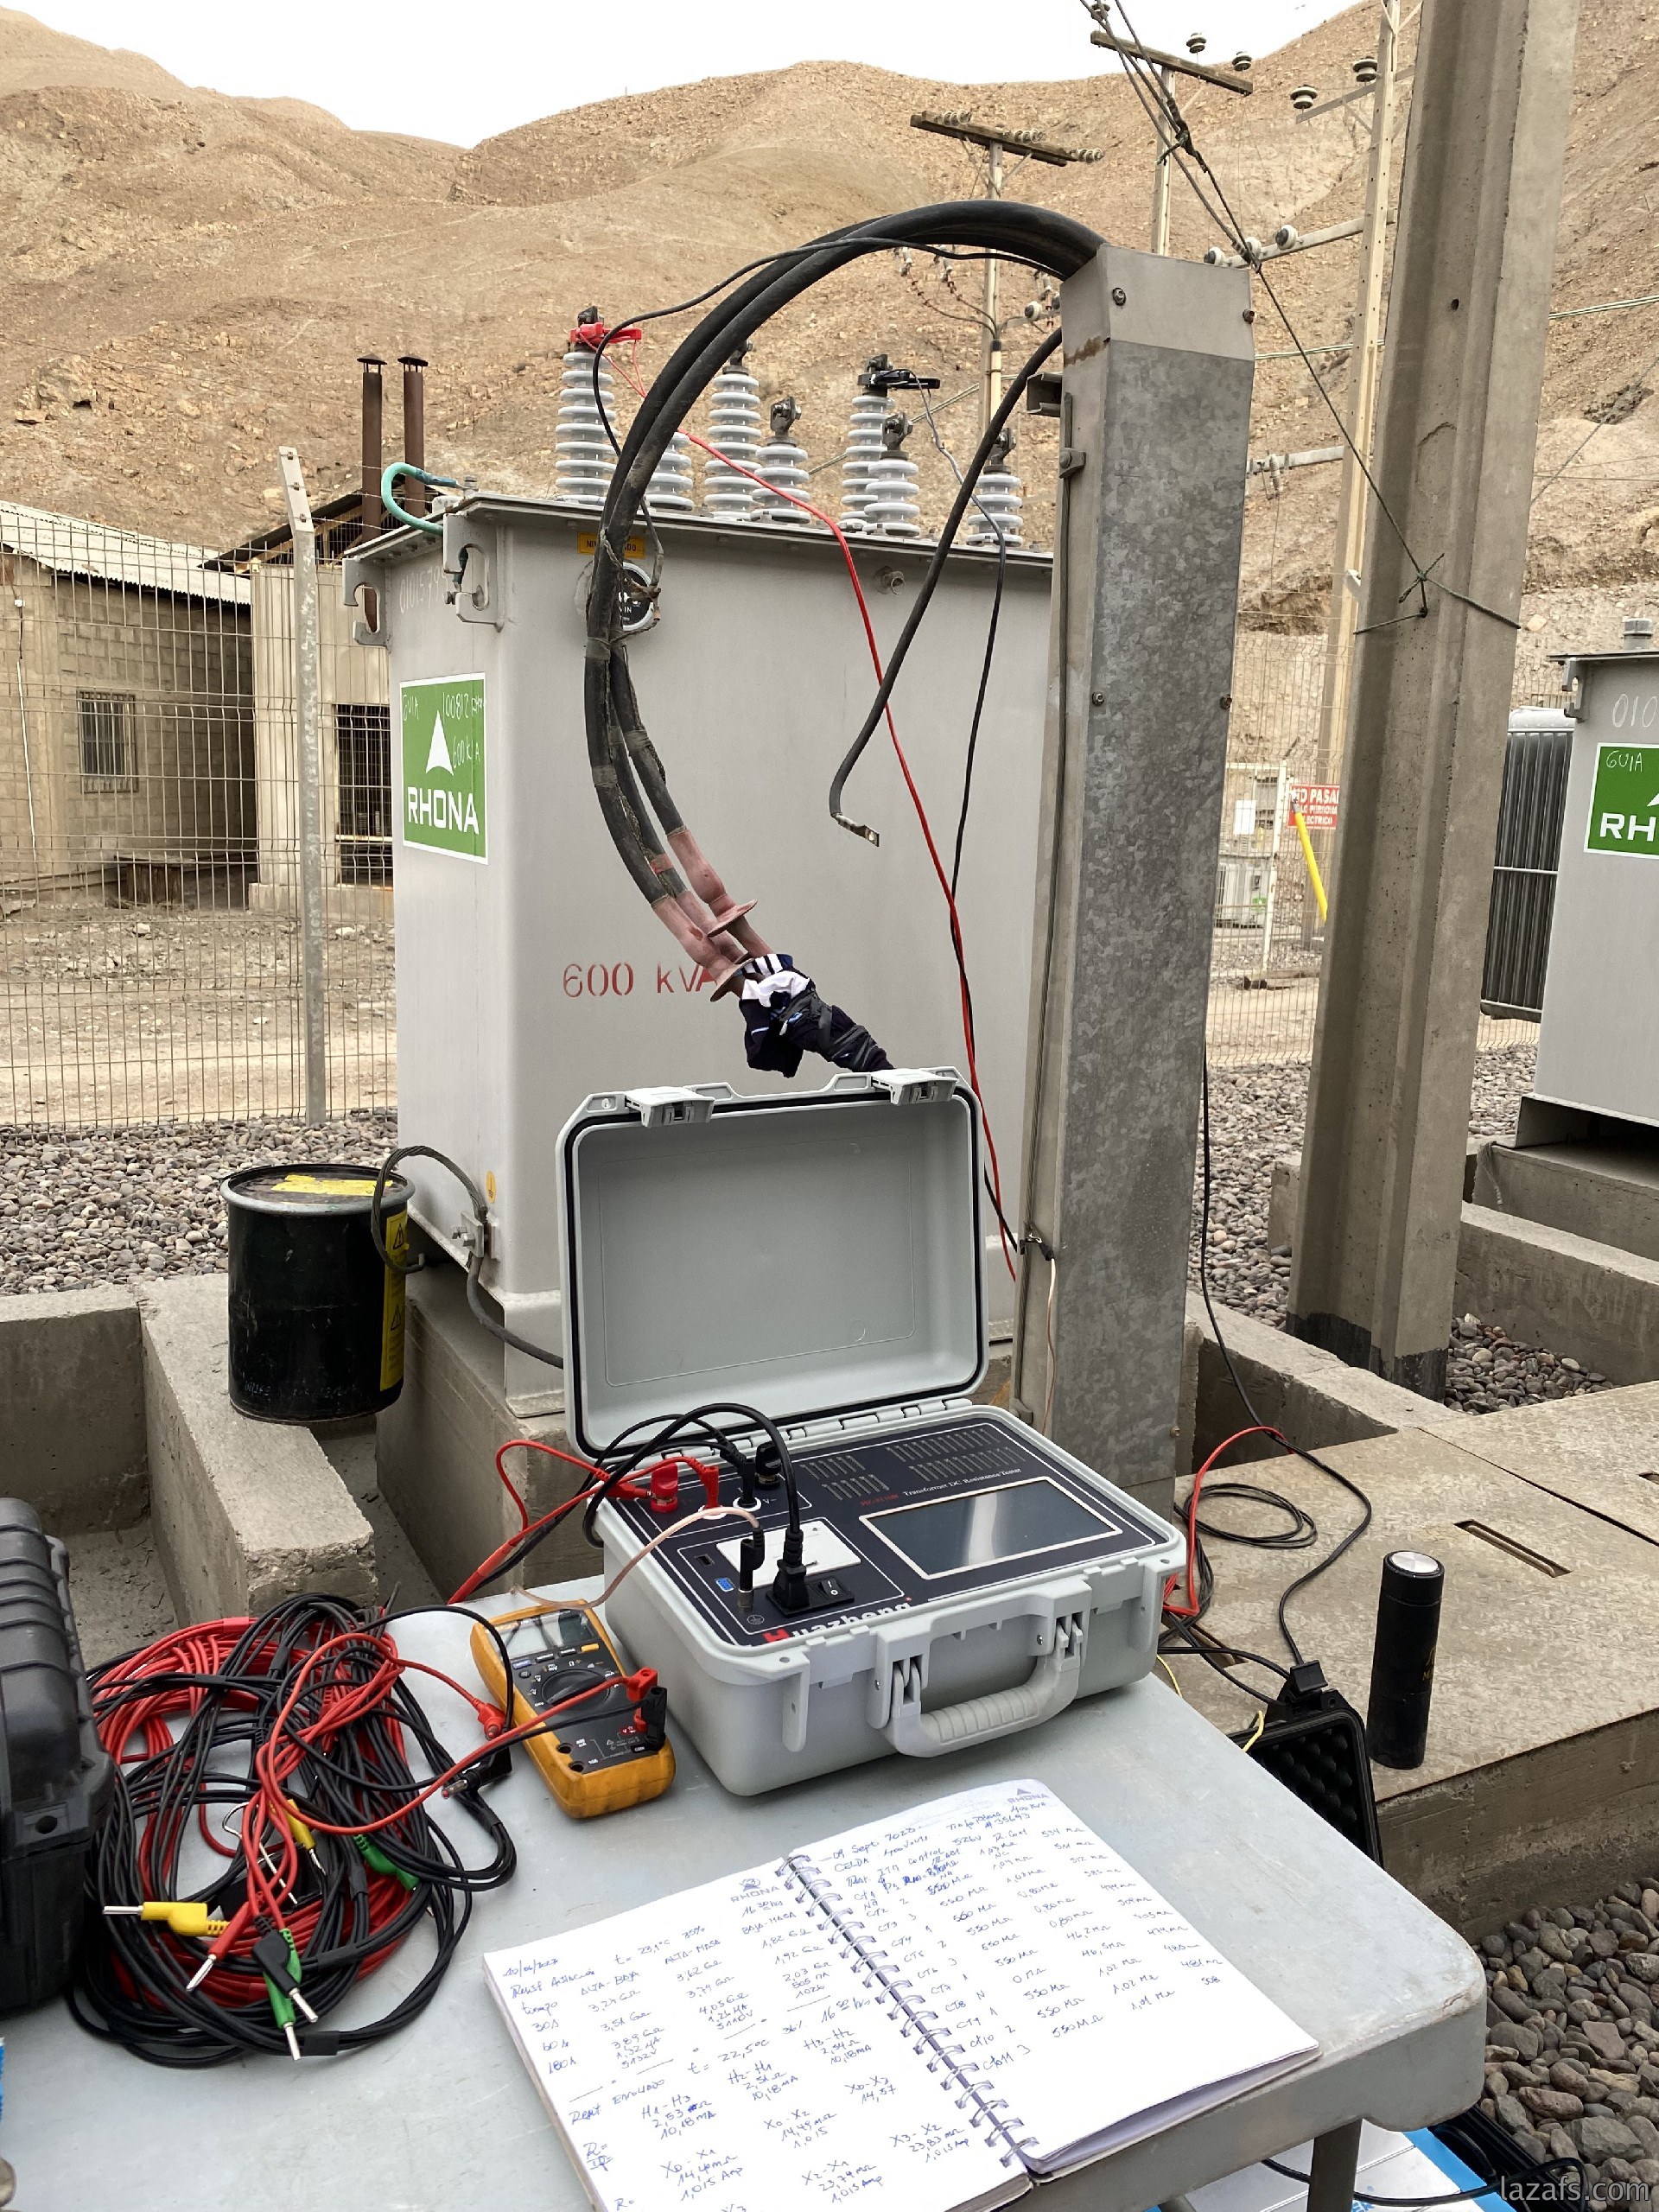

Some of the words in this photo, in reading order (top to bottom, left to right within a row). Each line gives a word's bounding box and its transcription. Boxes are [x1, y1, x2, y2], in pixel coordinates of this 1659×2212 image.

[1606, 750, 1643, 772] GUIA
[407, 786, 480, 835] RHONA
[563, 963, 634, 998] 600
[949, 1478, 963, 1489] DC
[878, 1922, 898, 1932] CT3
